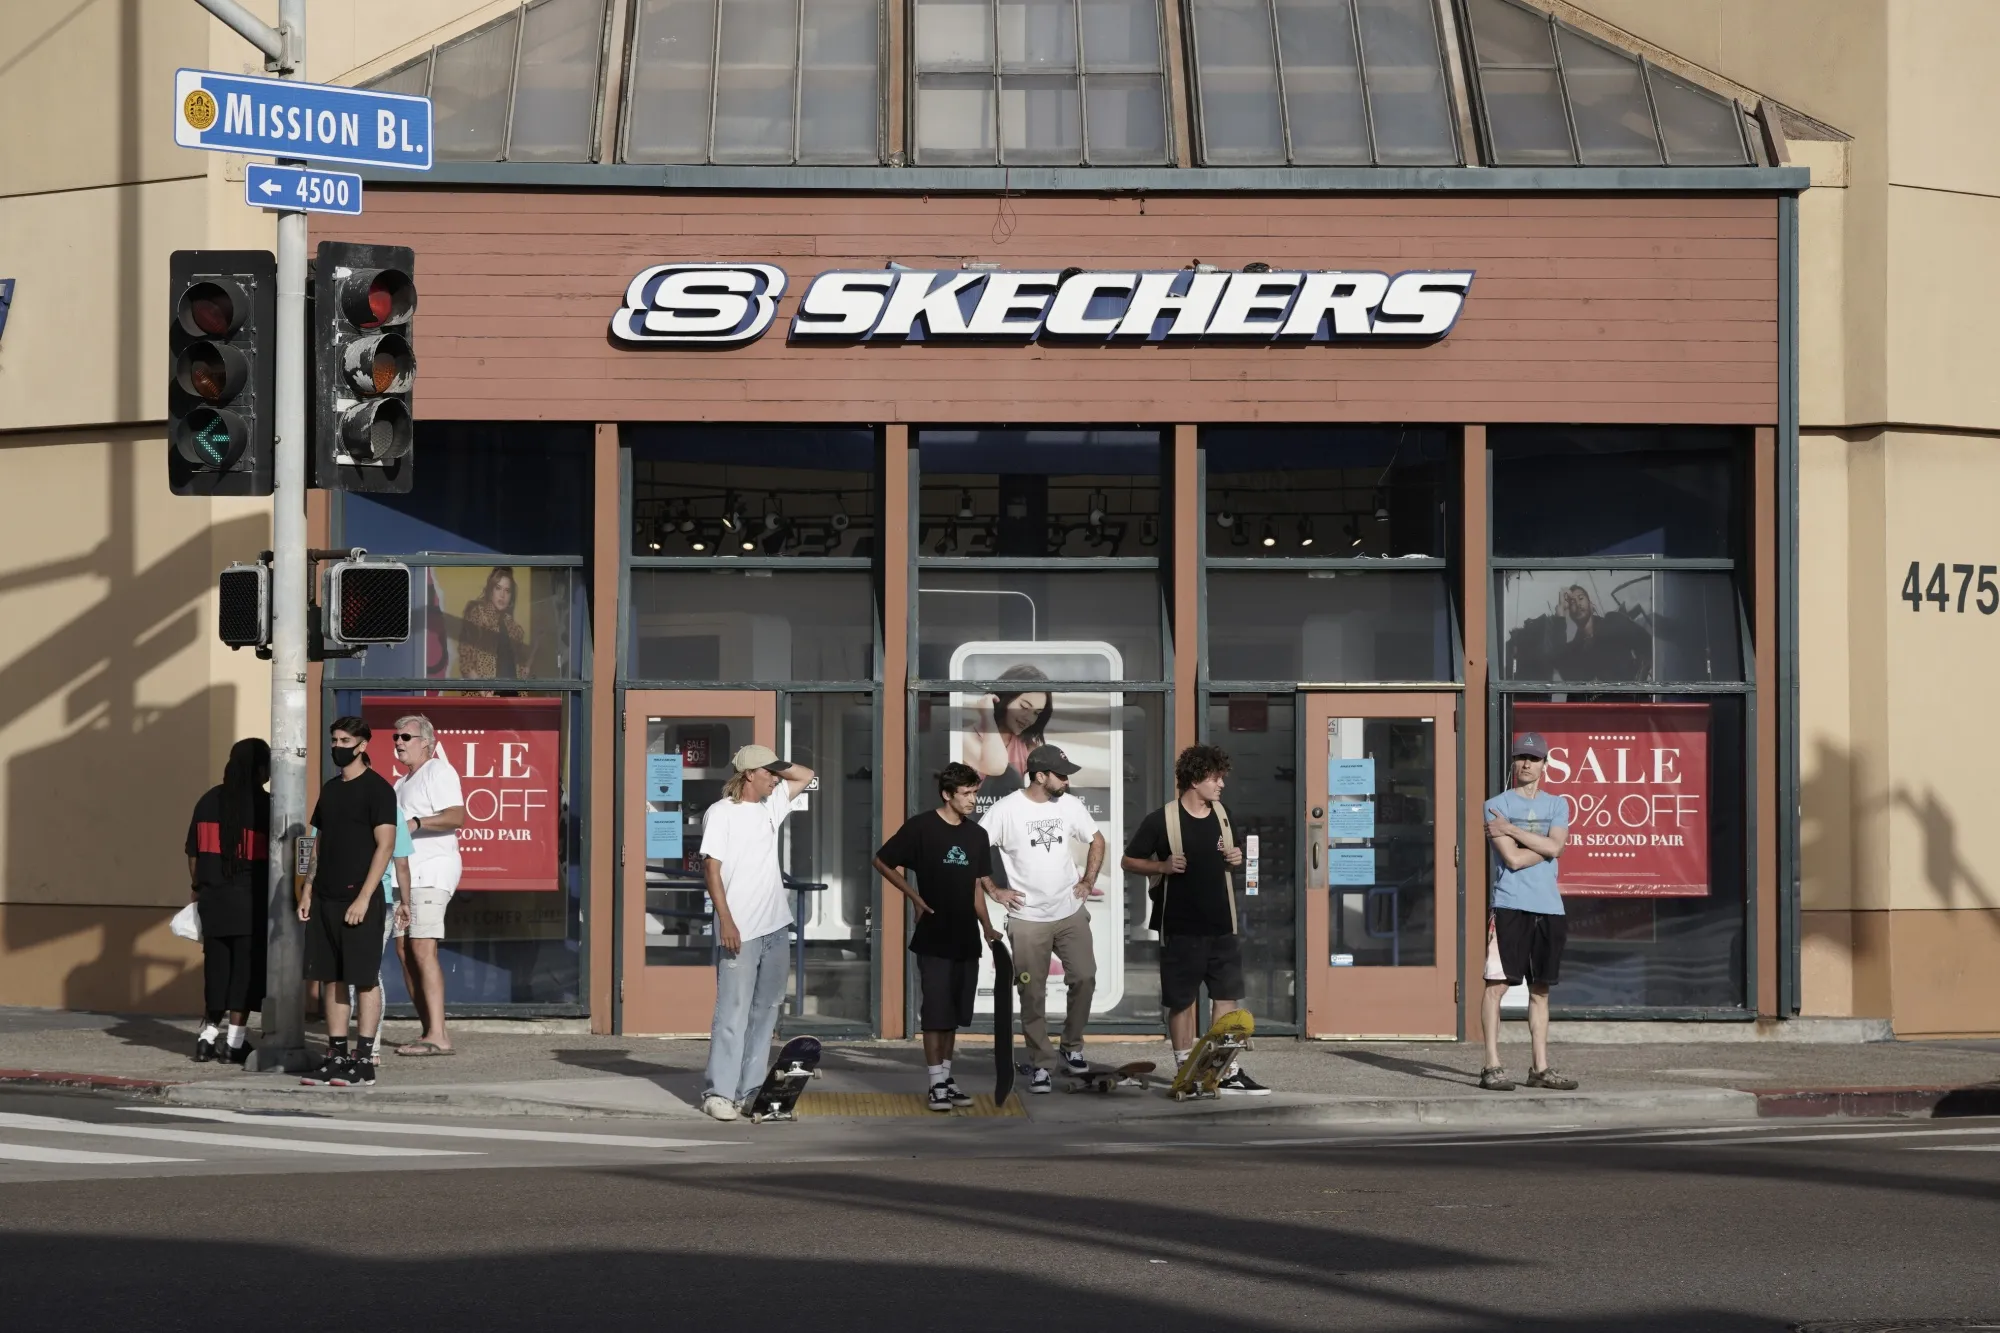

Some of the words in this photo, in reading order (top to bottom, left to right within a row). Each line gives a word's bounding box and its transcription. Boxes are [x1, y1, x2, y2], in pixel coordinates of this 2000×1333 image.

[296, 176, 349, 206] 4500
[793, 271, 1474, 337] SKECHERS
[1901, 561, 1999, 615] 4475
[686, 739, 706, 749] SALE
[1544, 746, 1682, 784] SALE
[465, 788, 548, 822] OFF
[1558, 794, 1612, 828] 0%
[1618, 793, 1700, 828] OFF
[455, 828, 495, 841] COND
[497, 828, 532, 841] PAIR
[1586, 834, 1647, 846] SECOND
[1650, 834, 1685, 846] PAIR
